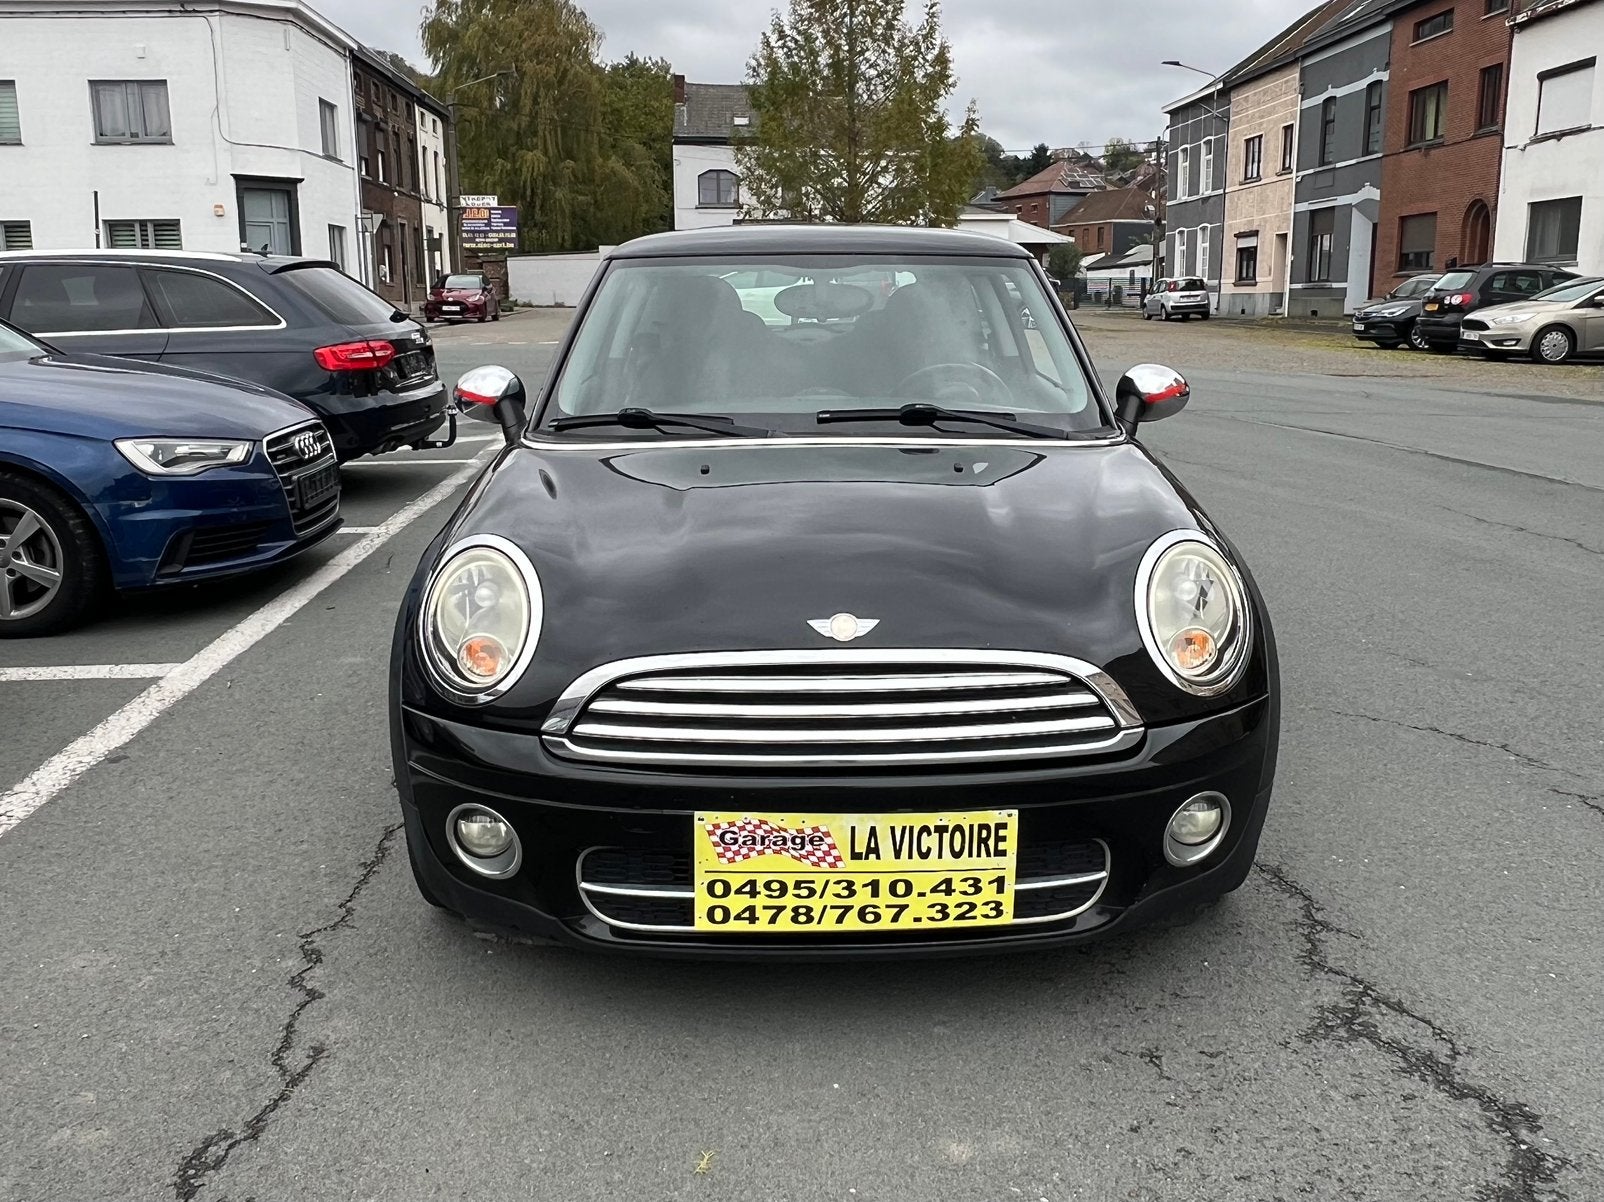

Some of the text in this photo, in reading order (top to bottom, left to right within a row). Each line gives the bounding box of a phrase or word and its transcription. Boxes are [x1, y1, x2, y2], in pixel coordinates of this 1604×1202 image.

[718, 828, 827, 852] Garage
[849, 822, 1009, 861] LA VICTOIRE
[705, 875, 1007, 900] 0495/310.431
[705, 900, 1005, 926] 0478/767.323
